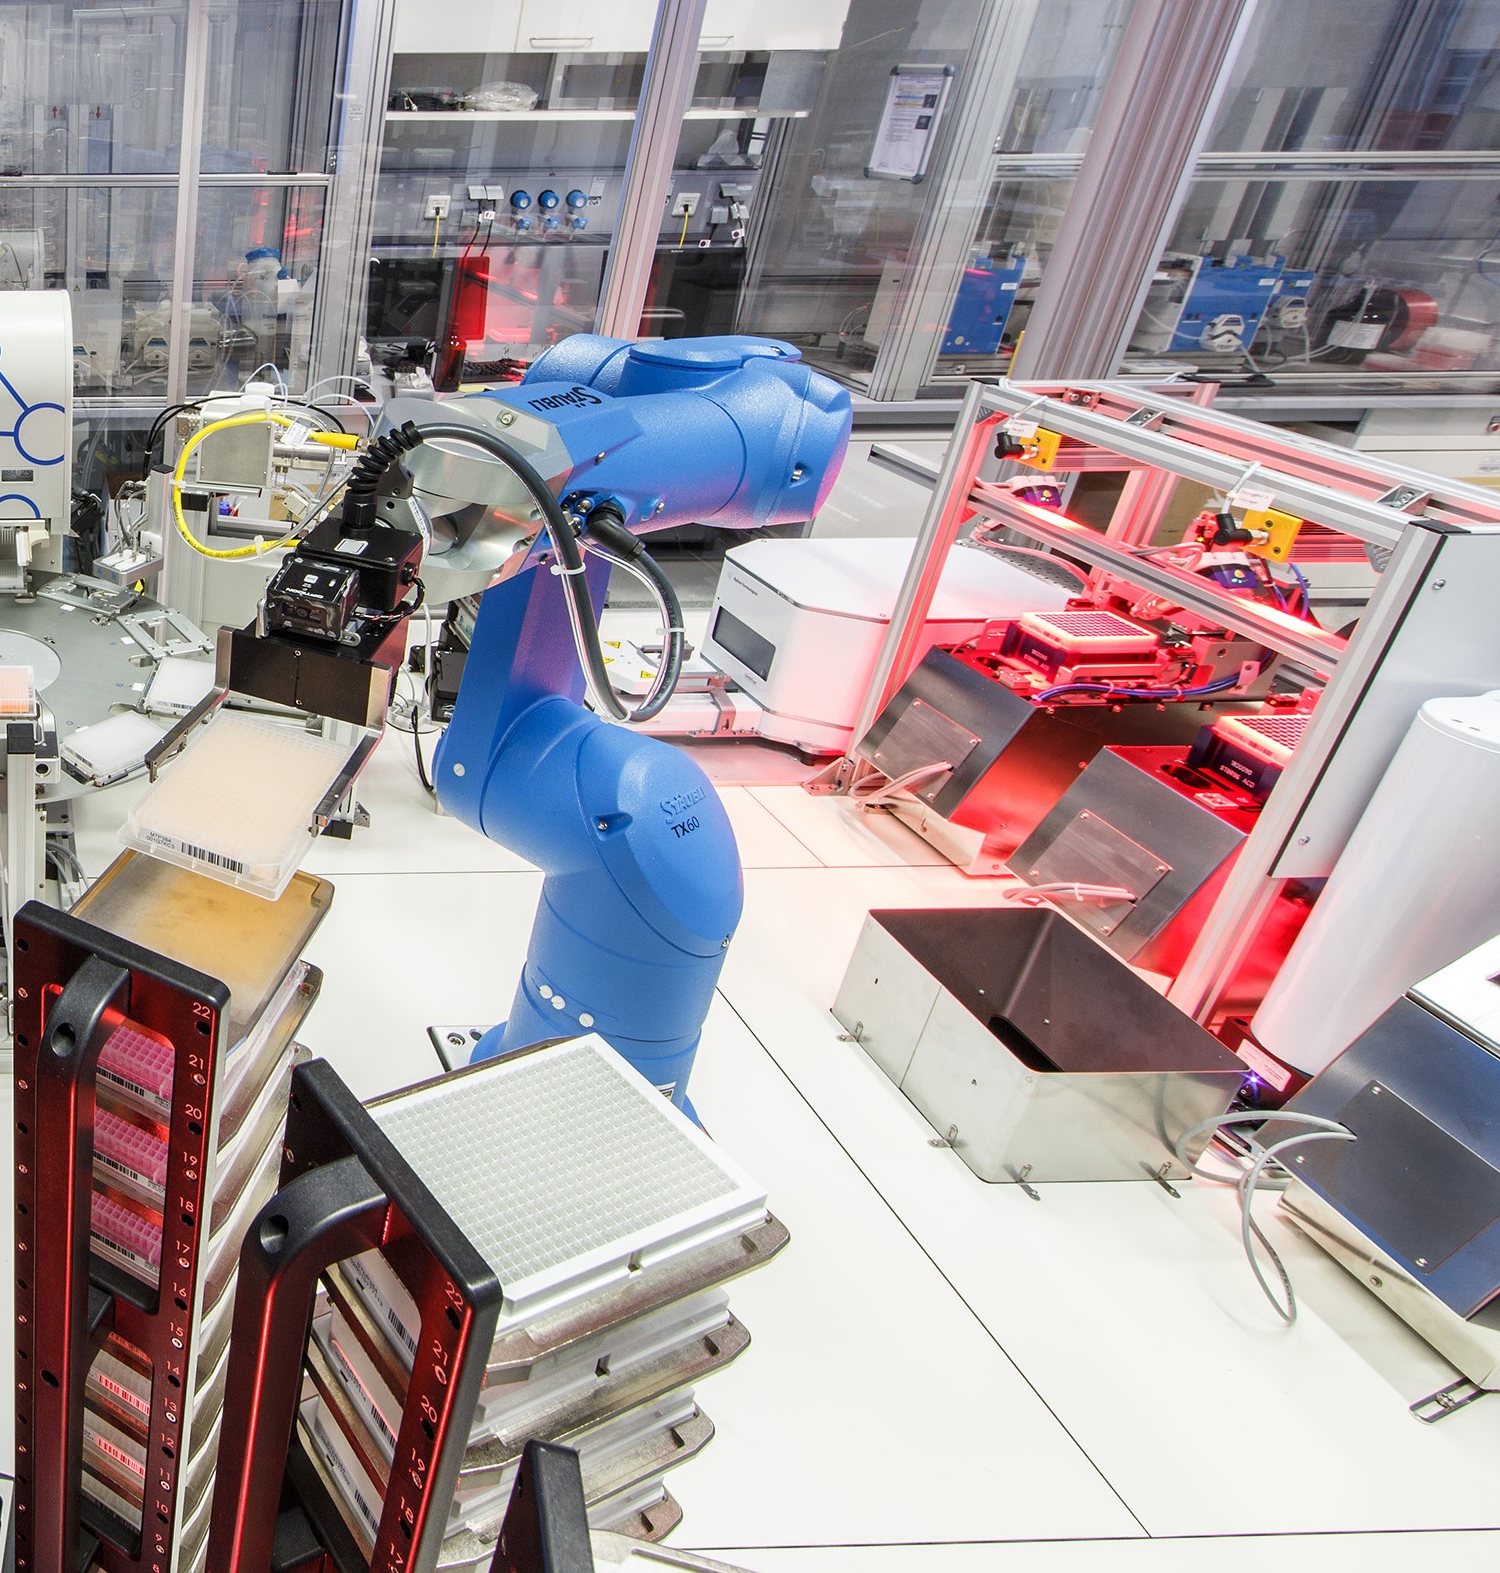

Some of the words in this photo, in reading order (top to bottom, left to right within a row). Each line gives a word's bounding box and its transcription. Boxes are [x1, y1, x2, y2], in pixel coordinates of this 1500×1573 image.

[528, 386, 602, 411] STÄUBLI
[660, 786, 706, 825] STÄUBLI
[671, 815, 700, 838] TX60
[192, 1002, 211, 1020] 22
[188, 1054, 204, 1070] 21
[184, 1103, 202, 1120] 20
[182, 1151, 198, 1167] 19
[179, 1196, 195, 1212] 18
[175, 1239, 191, 1254] 17
[172, 1281, 188, 1298] 16
[444, 1281, 465, 1313] 22
[169, 1321, 184, 1337] 15
[432, 1339, 449, 1367] 21
[166, 1360, 180, 1375] 14
[163, 1397, 178, 1412] 13
[420, 1395, 438, 1423] 20
[160, 1433, 175, 1449] 12
[410, 1447, 427, 1472] 19
[159, 1467, 171, 1481] 11
[155, 1500, 169, 1514] 10
[400, 1496, 415, 1526] 18
[155, 1533, 163, 1542] 9
[389, 1543, 405, 1567] 17
[152, 1564, 160, 1573] 8
